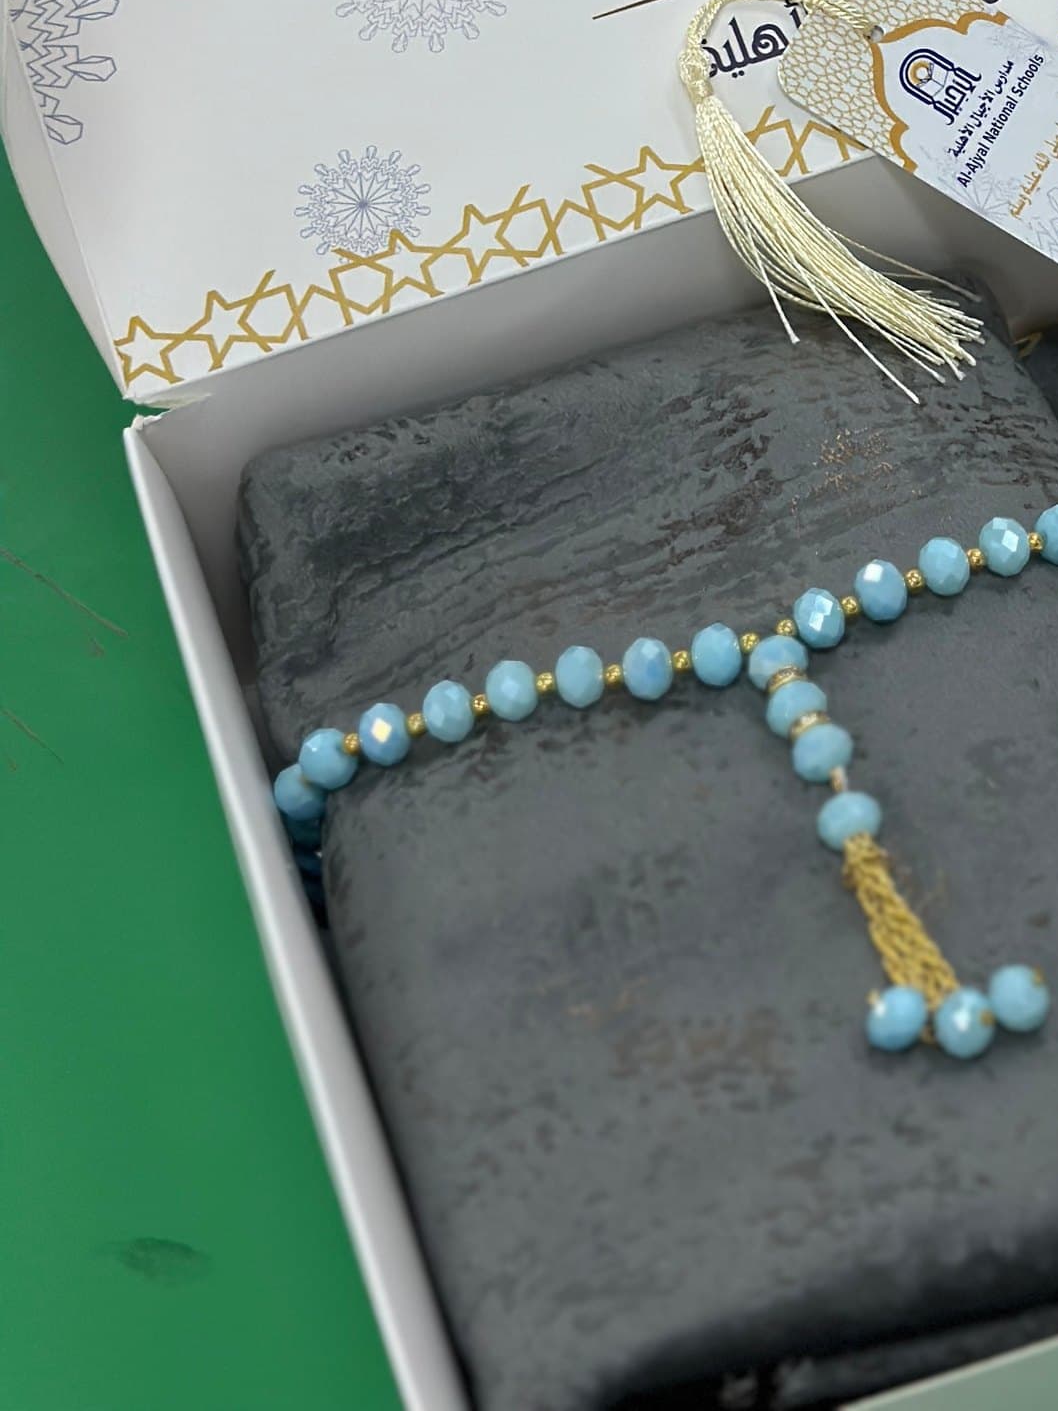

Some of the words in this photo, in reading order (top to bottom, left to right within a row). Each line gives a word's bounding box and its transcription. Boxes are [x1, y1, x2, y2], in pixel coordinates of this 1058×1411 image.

[994, 60, 1014, 95] مدارس
[957, 141, 991, 188] Al-Ajyal
[982, 95, 1019, 145] National
[1011, 54, 1044, 98] Schools
[970, 89, 996, 129] الأجيال
[947, 122, 975, 158] الأهلية
